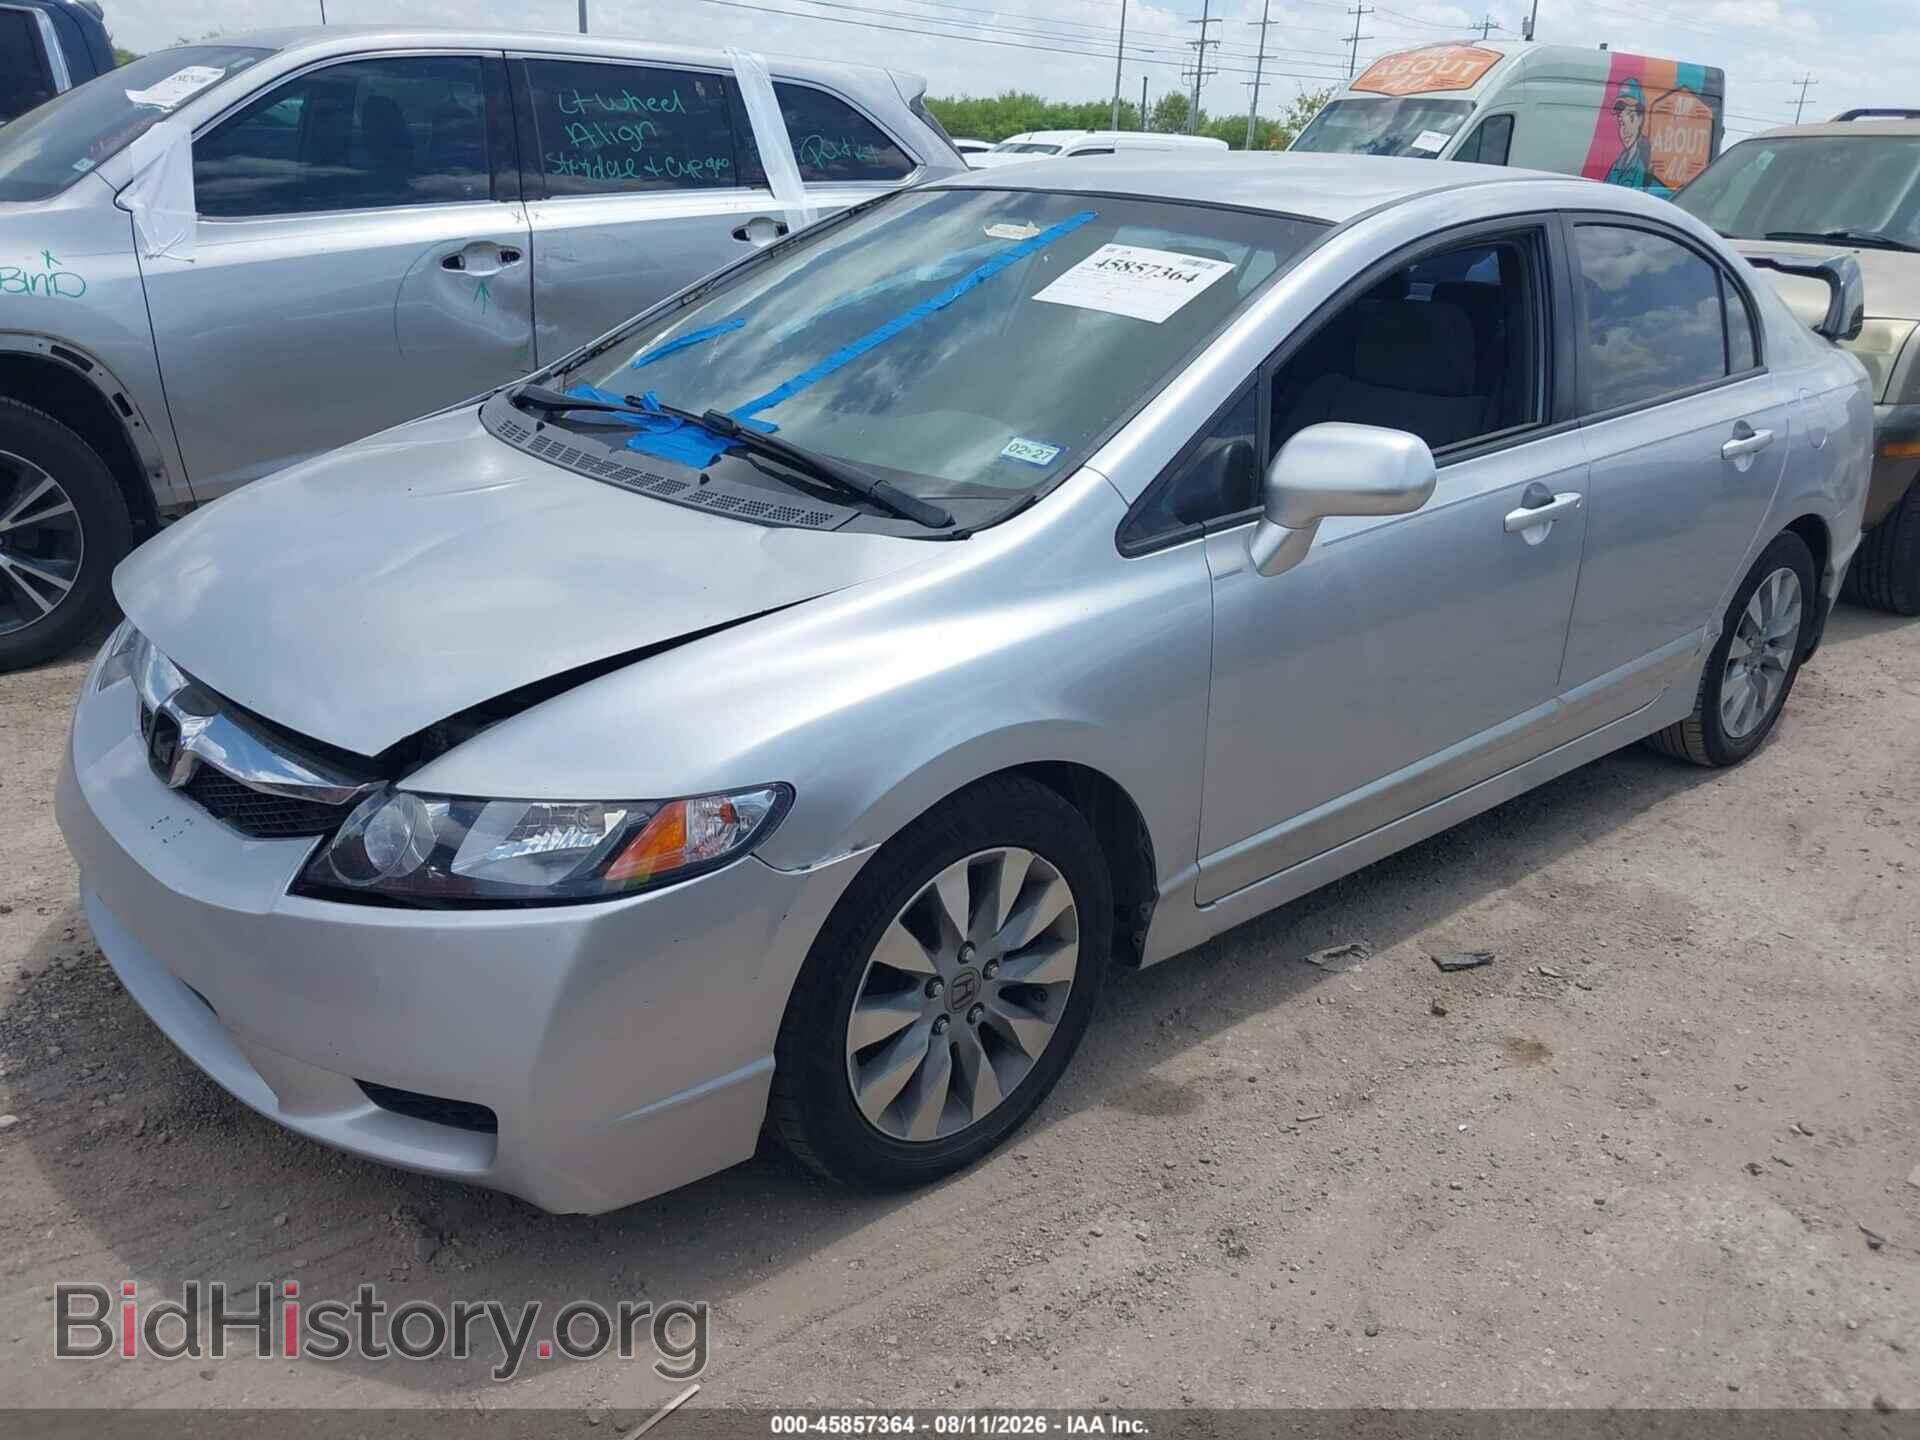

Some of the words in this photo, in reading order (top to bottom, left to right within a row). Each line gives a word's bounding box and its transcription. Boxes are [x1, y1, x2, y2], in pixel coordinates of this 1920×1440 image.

[1375, 58, 1484, 81] ABOUT
[565, 121, 657, 152] Align
[1651, 125, 1708, 155] ABOUT
[1095, 258, 1200, 283] 45857364
